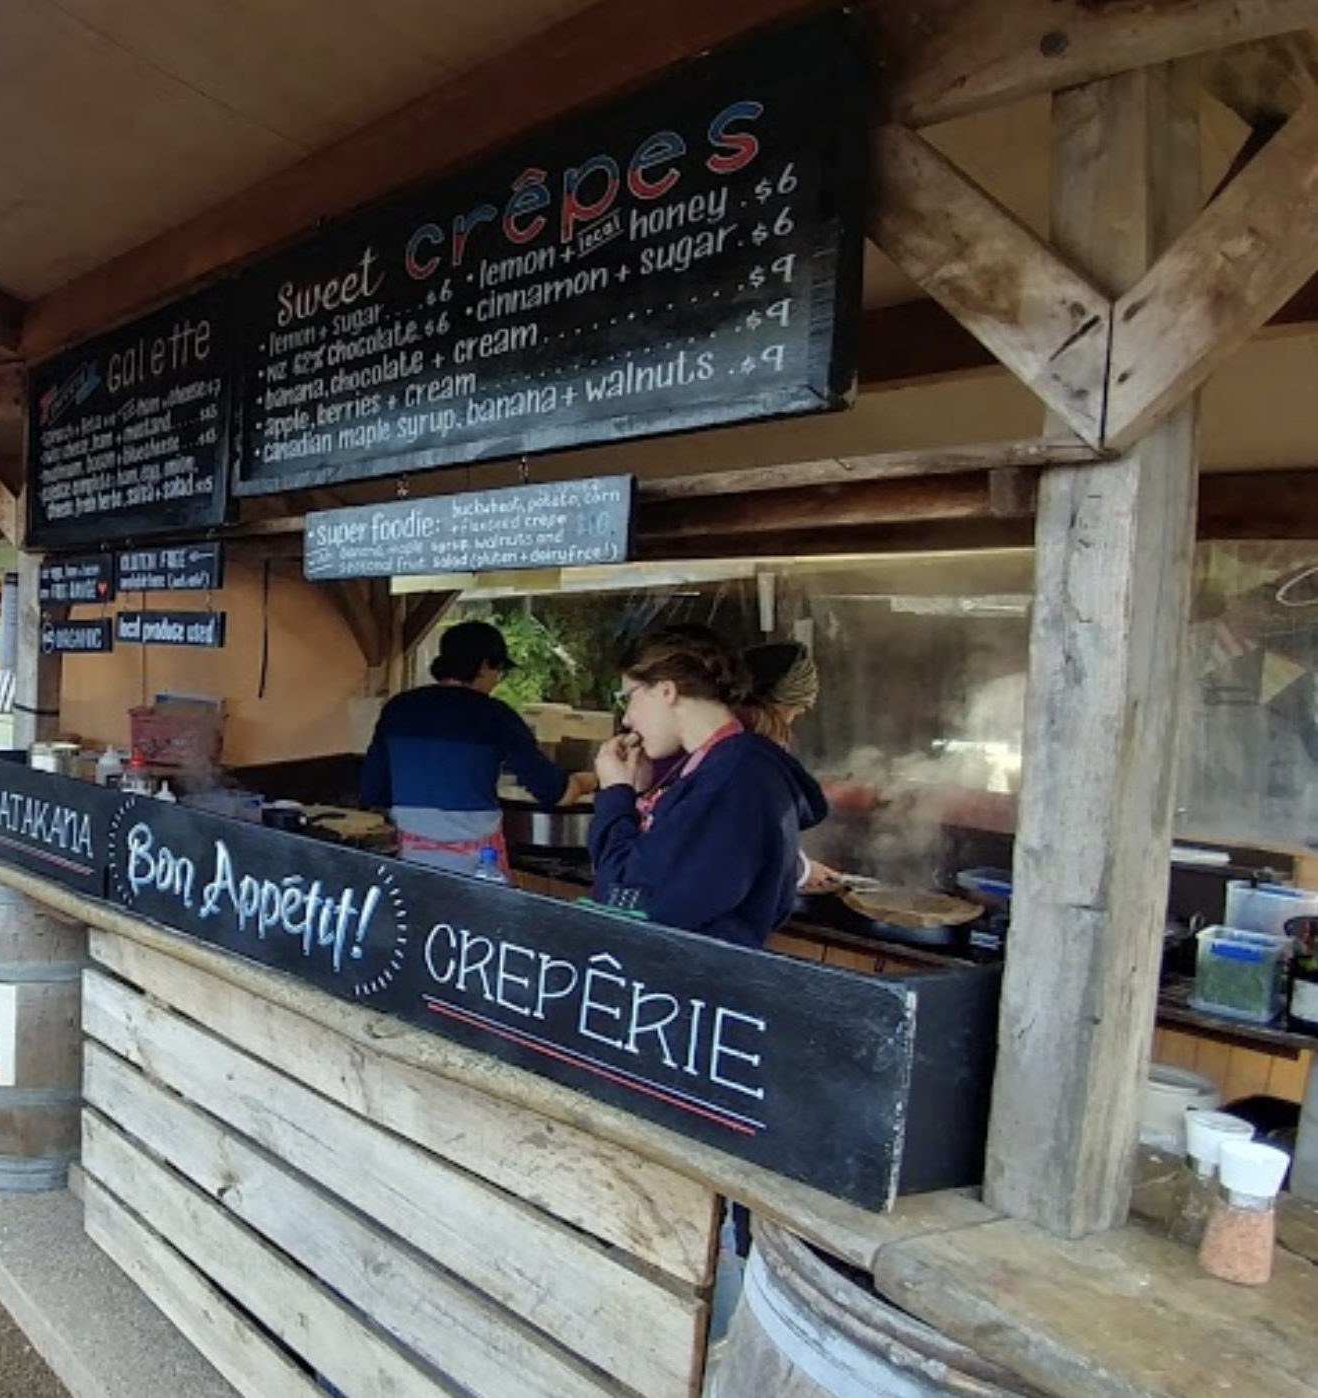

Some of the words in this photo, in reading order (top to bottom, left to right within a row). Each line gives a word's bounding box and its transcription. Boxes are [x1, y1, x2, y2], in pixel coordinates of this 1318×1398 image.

[277, 247, 385, 326] Sweet
[405, 101, 765, 280] crêpes
[476, 266, 609, 322] cinnamon
[639, 223, 739, 276] sugar
[751, 207, 795, 246] $6
[480, 247, 556, 289] lemon
[629, 187, 728, 241] honey
[754, 162, 798, 202] $6
[106, 318, 212, 394] Galette
[269, 326, 316, 357] lemon
[332, 303, 384, 336] sugar
[316, 390, 382, 427] berries
[404, 372, 477, 408] cream
[745, 297, 794, 331] $9
[327, 319, 419, 366] chocolate
[331, 350, 424, 394] chocolate
[453, 322, 538, 364] cream
[748, 253, 797, 289] $9
[263, 432, 333, 463] canadian
[338, 416, 391, 451] maple
[466, 385, 556, 427] banana
[585, 350, 715, 403] walnuts
[739, 343, 786, 375] $9
[316, 522, 368, 548] super
[583, 489, 621, 505] corn
[127, 821, 195, 908] Bon
[198, 838, 381, 973] Appétit!
[423, 922, 767, 1100] CREPÊRIE
